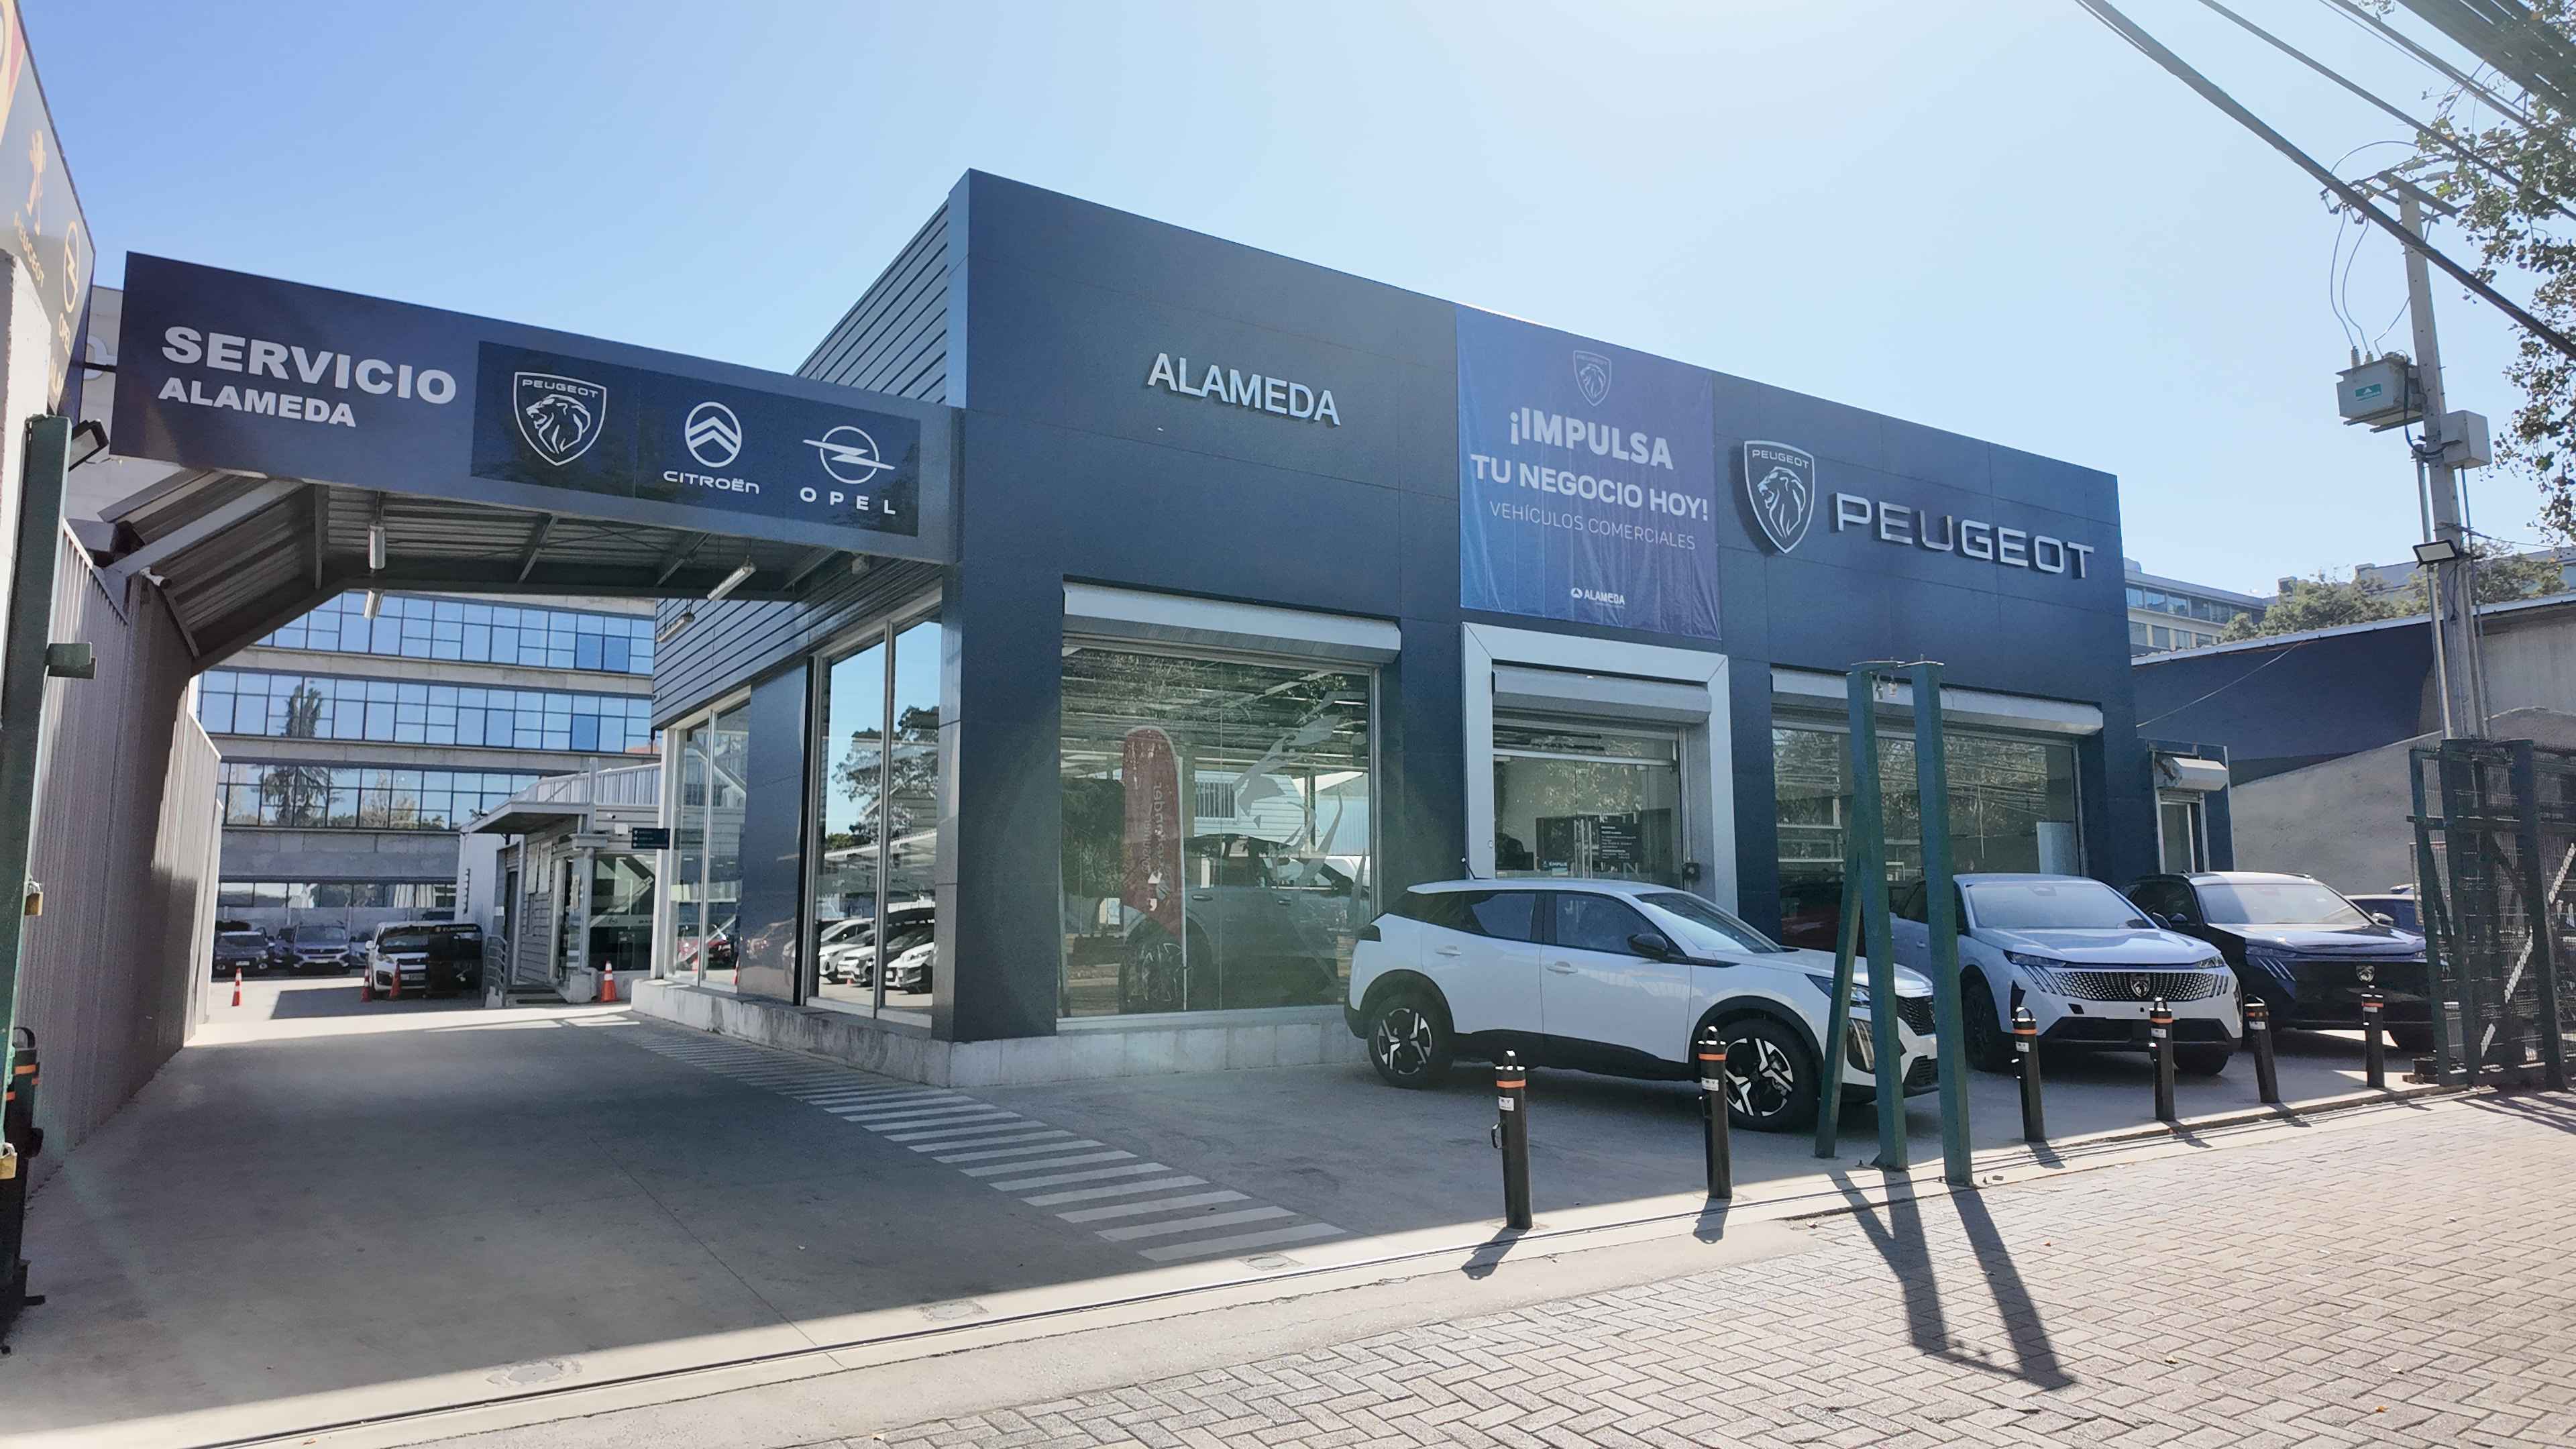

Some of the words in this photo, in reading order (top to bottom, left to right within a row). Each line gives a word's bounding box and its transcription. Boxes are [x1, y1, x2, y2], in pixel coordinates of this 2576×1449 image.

[161, 325, 458, 405] SERVICIO
[522, 379, 599, 398] PEUGEOT
[1147, 352, 1341, 426] ALAMEDA
[158, 376, 357, 427] ALAMEDA
[1509, 407, 1674, 470] ¡IMPULSA
[1752, 449, 1809, 469] PEUGEOT
[800, 487, 896, 515] OPEL
[1470, 453, 1511, 484] TU
[1519, 462, 1643, 508] NEGOCIO
[1650, 488, 1709, 521] HOY!
[1489, 500, 1584, 531] VEHÍCULOS
[1588, 518, 1697, 550] COMERCIALES
[1835, 492, 2094, 579] PEUGEOT
[1584, 588, 1625, 605] ALAMEDA
